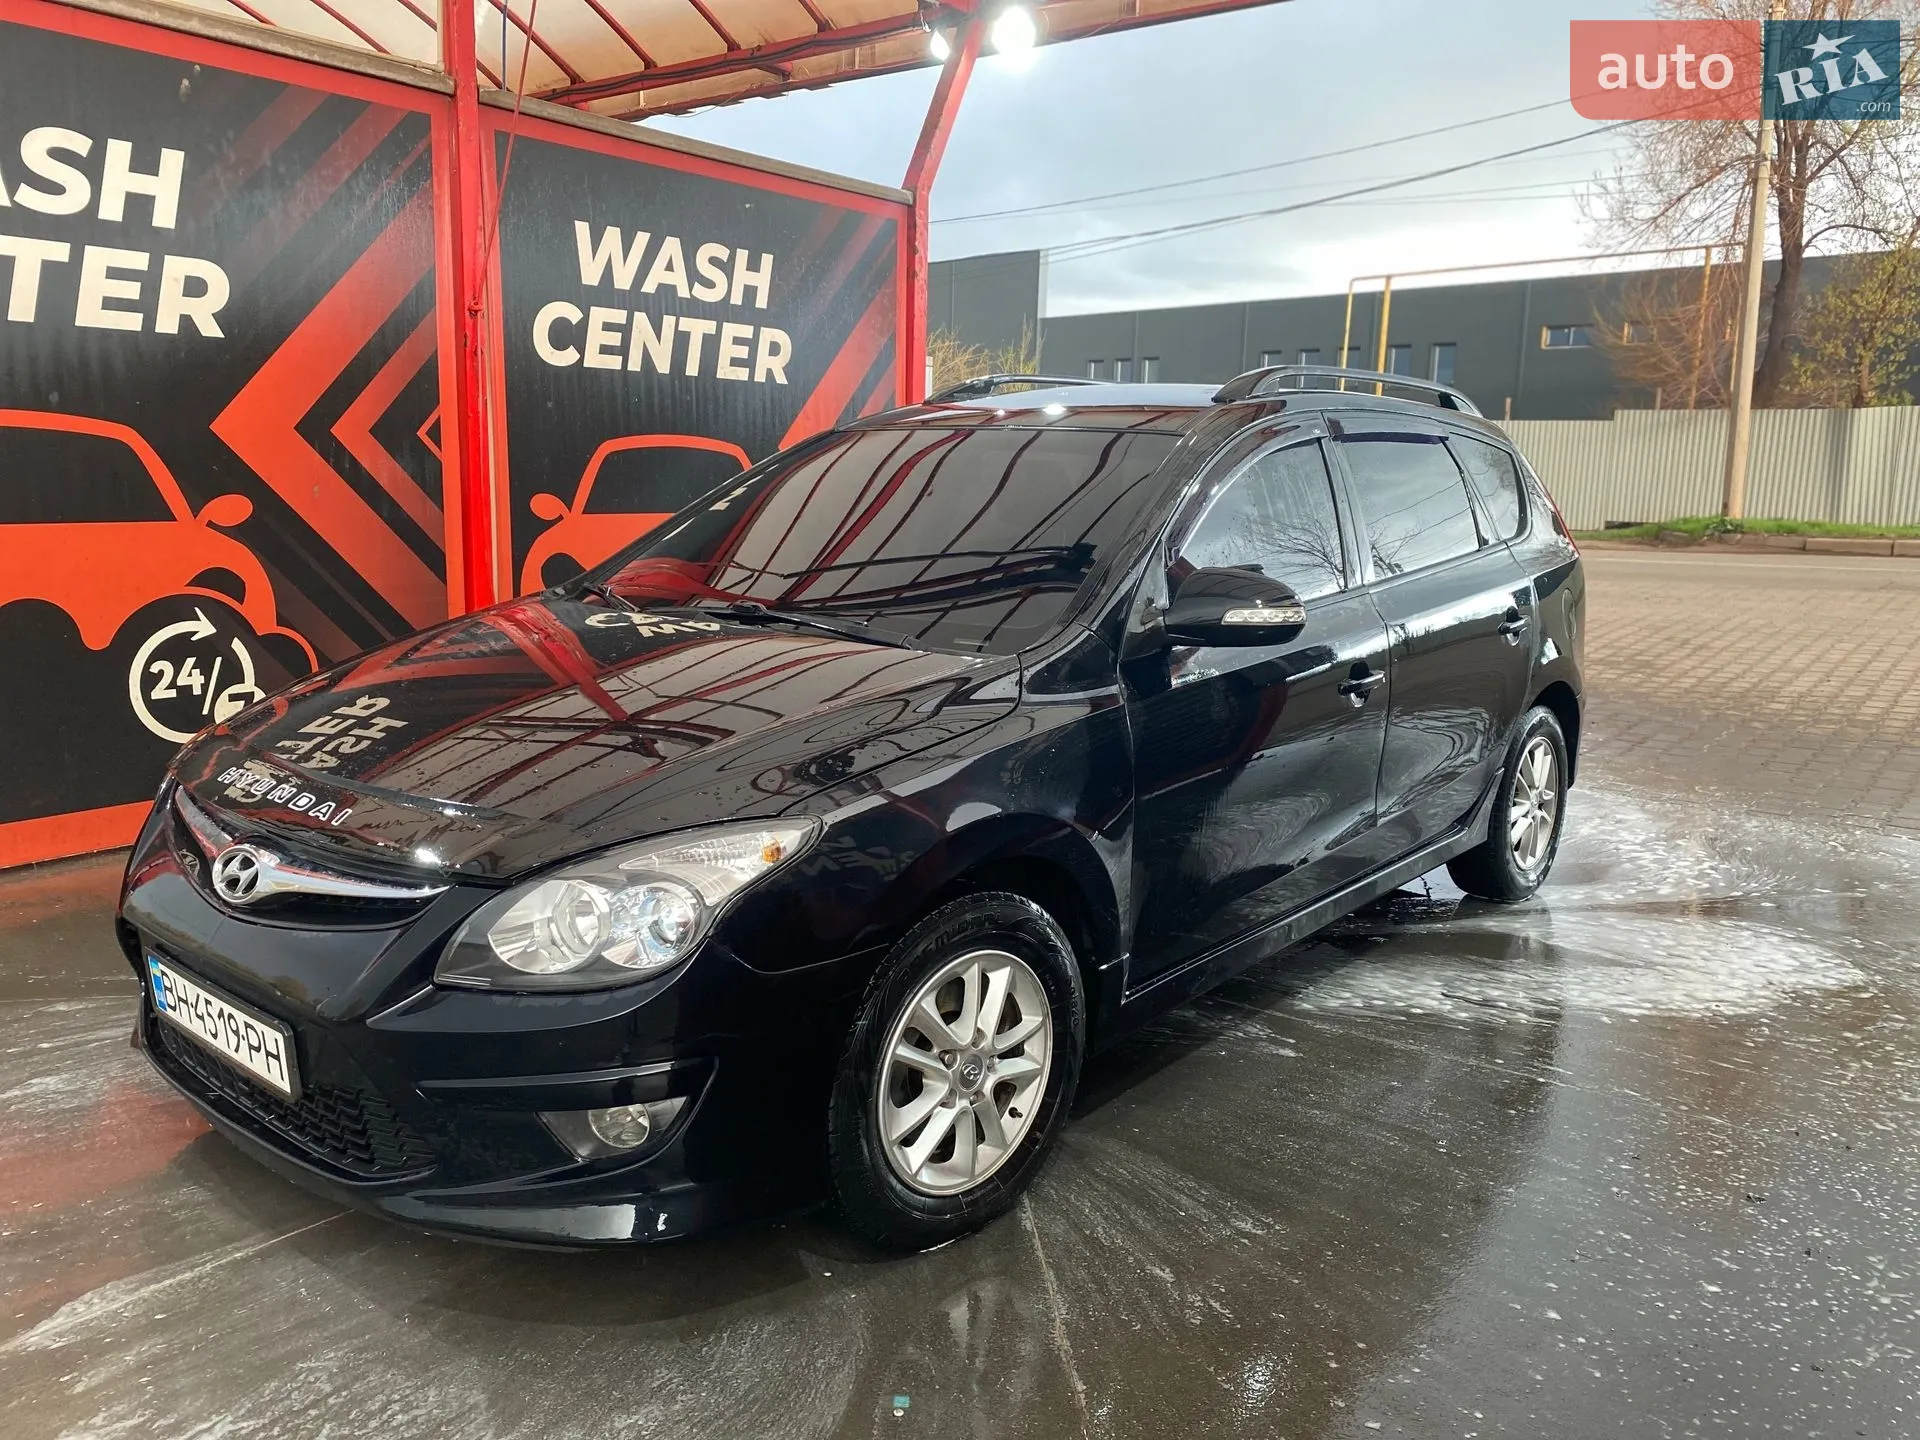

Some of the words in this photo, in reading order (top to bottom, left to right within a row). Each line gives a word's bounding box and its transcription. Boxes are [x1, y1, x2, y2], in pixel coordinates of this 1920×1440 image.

[0, 235, 230, 338] TER
[574, 220, 774, 309] WASH
[533, 301, 792, 385] CENTER
[217, 766, 353, 827] HYUNDAI
